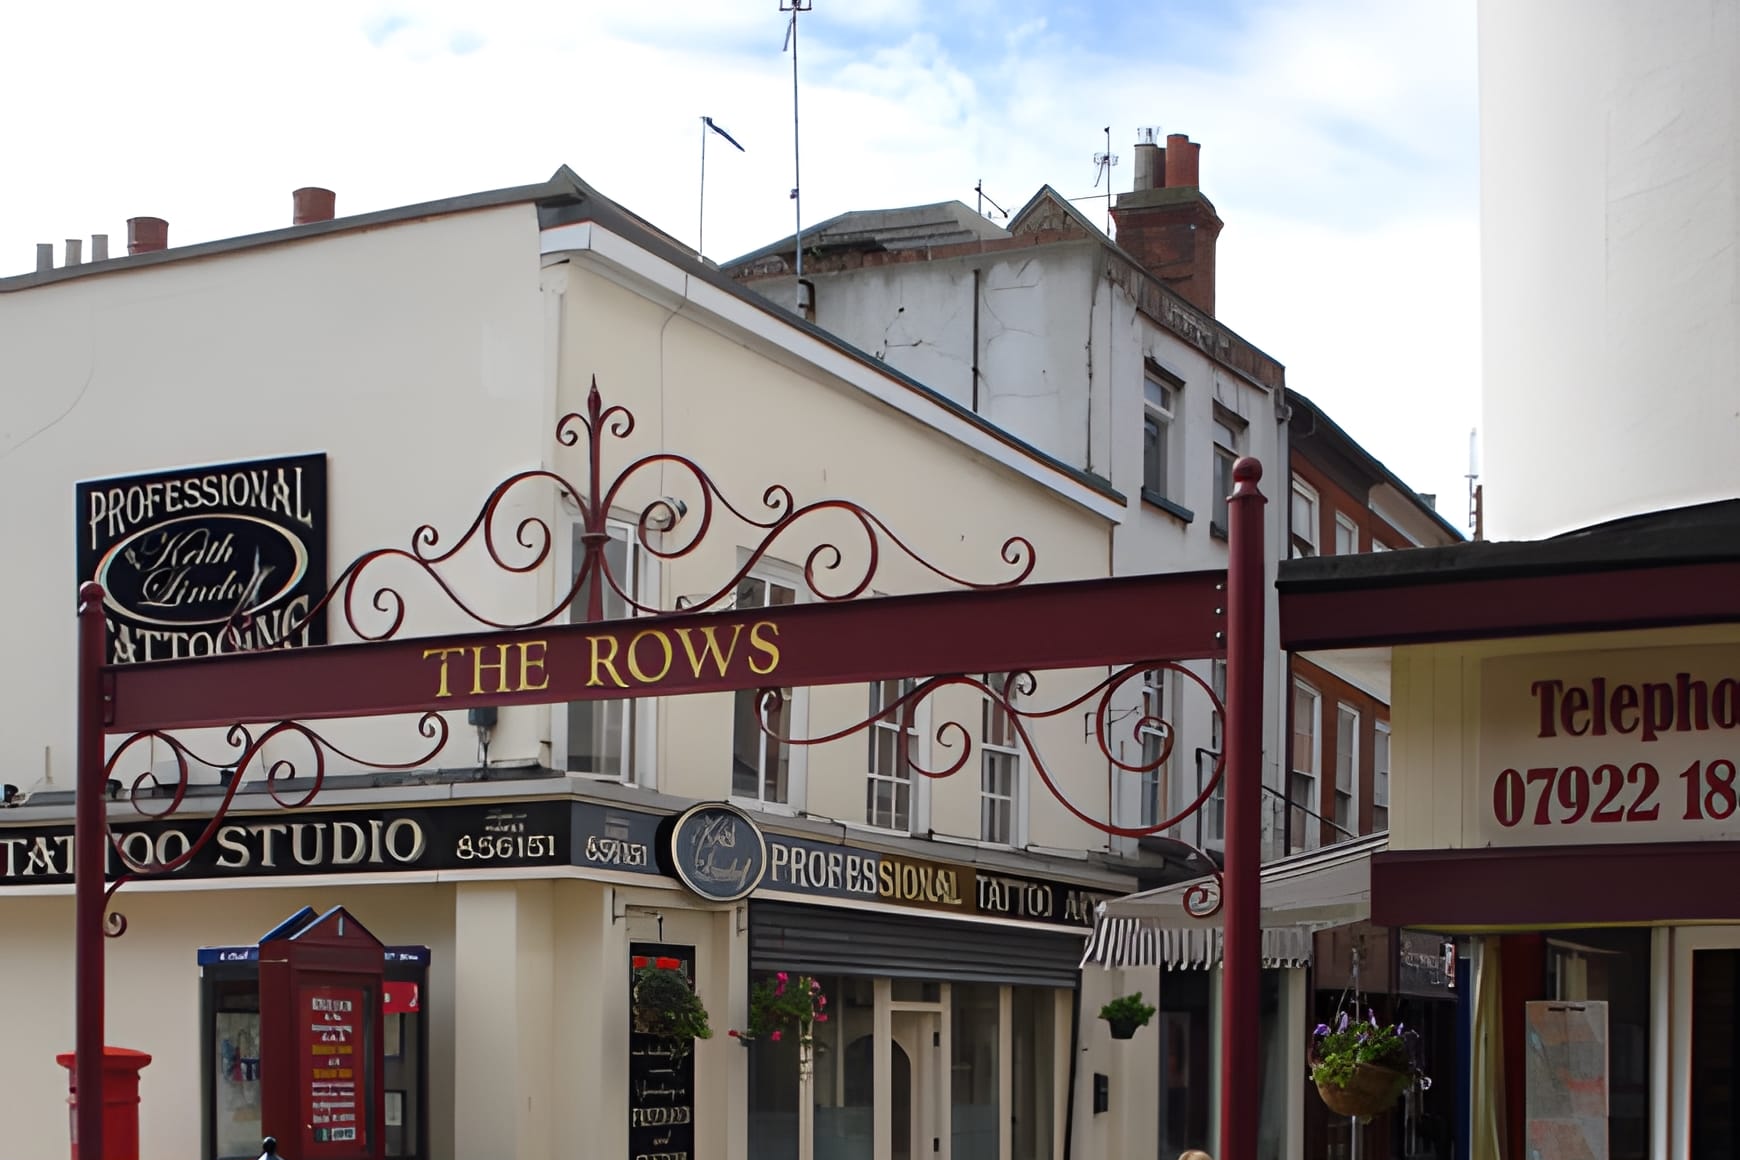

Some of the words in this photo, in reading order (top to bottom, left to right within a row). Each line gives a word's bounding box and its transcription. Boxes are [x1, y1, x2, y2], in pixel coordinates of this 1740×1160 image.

[89, 466, 314, 550] PROFESSIONAL
[423, 640, 550, 697] THE
[585, 621, 781, 688] ROWS
[1493, 762, 1661, 827] 07922
[1678, 759, 1740, 820] 18
[215, 818, 426, 868] STUDIO
[771, 843, 963, 905] PROFESSIONAL
